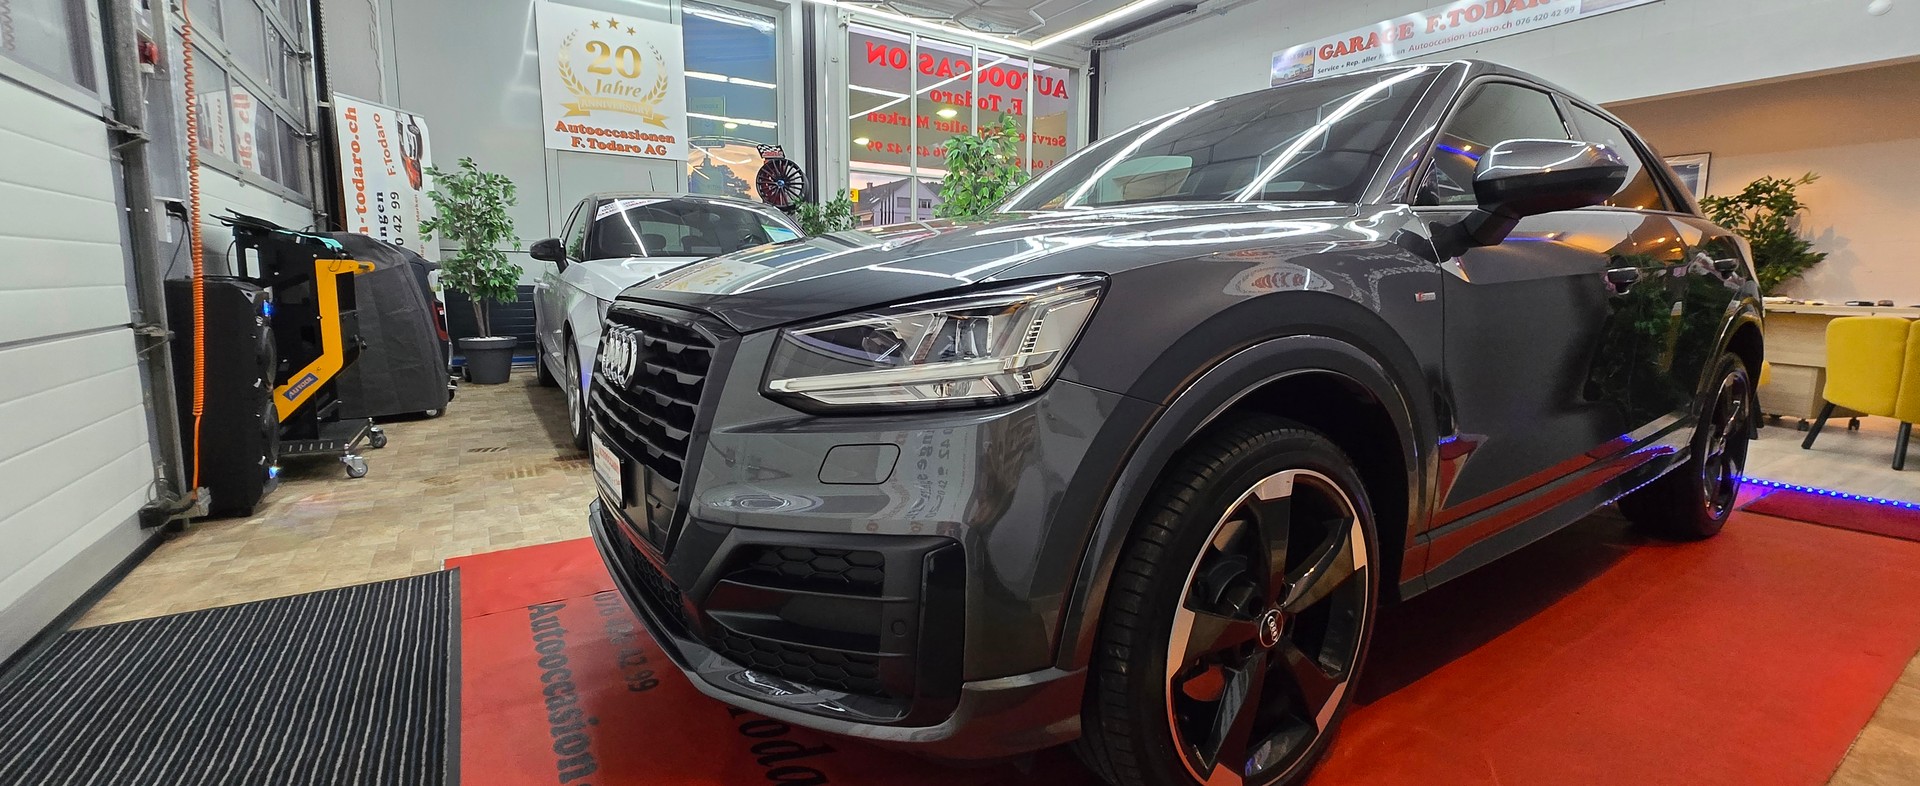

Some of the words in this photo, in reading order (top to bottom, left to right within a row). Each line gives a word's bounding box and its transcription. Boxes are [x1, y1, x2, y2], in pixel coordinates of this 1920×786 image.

[1318, 64, 1340, 74] Service
[1346, 58, 1361, 68] Rep.
[1361, 55, 1378, 64] aller
[1378, 48, 1406, 59] Men
[1408, 20, 1513, 52] Autooccasion-todaro.ch
[1515, 17, 1531, 27] 076
[1532, 12, 1549, 22] 420
[1551, 9, 1562, 18] 42
[1564, 6, 1576, 15] 99
[1319, 22, 1415, 60] GARAGE
[1425, 0, 1558, 34] F.TODA
[585, 40, 642, 79] 20
[595, 78, 642, 98] Jahre
[555, 120, 676, 144] Autooccasionen
[571, 136, 586, 149] F.
[587, 138, 641, 153] Todaro
[644, 144, 668, 156] AG
[390, 191, 400, 210] 99
[392, 215, 402, 234] 42
[289, 376, 313, 399] AUTOOL
[617, 648, 648, 669] 42
[623, 669, 660, 692] 99
[528, 602, 599, 786] Autooccasion
